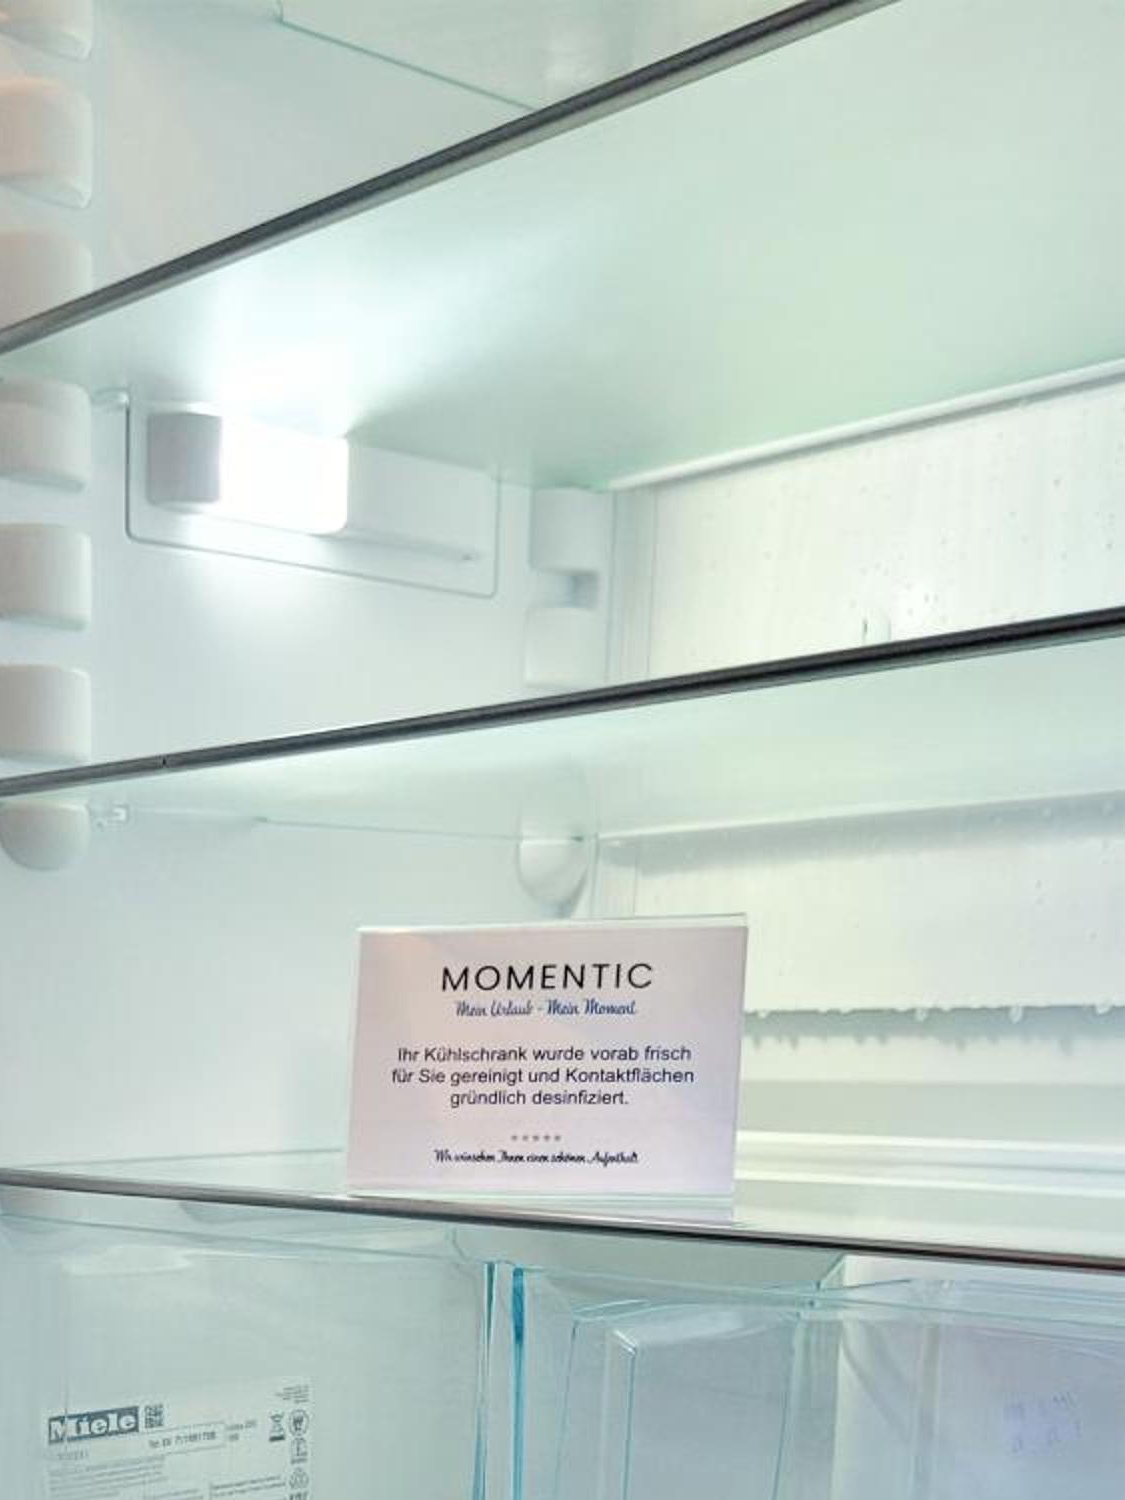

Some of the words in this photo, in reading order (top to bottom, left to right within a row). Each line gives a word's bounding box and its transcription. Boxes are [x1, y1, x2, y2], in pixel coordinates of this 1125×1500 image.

[441, 963, 653, 991] MOMENTIC
[547, 998, 579, 1015] Mein
[584, 998, 636, 1015] Moment
[397, 1047, 419, 1061] Ihr
[424, 1046, 527, 1062] Kühlschrank
[532, 1046, 584, 1061] wurde
[590, 1046, 639, 1061] vorab
[644, 1045, 692, 1061] frisch
[392, 1068, 414, 1083] für
[418, 1068, 446, 1083] Sie
[450, 1068, 523, 1087] gereinigt
[528, 1068, 560, 1083] und
[565, 1067, 694, 1083] Kontaktflächen
[450, 1090, 527, 1109] gründlich
[531, 1090, 629, 1105] desinfiziert.
[50, 1413, 136, 1441] Miele
